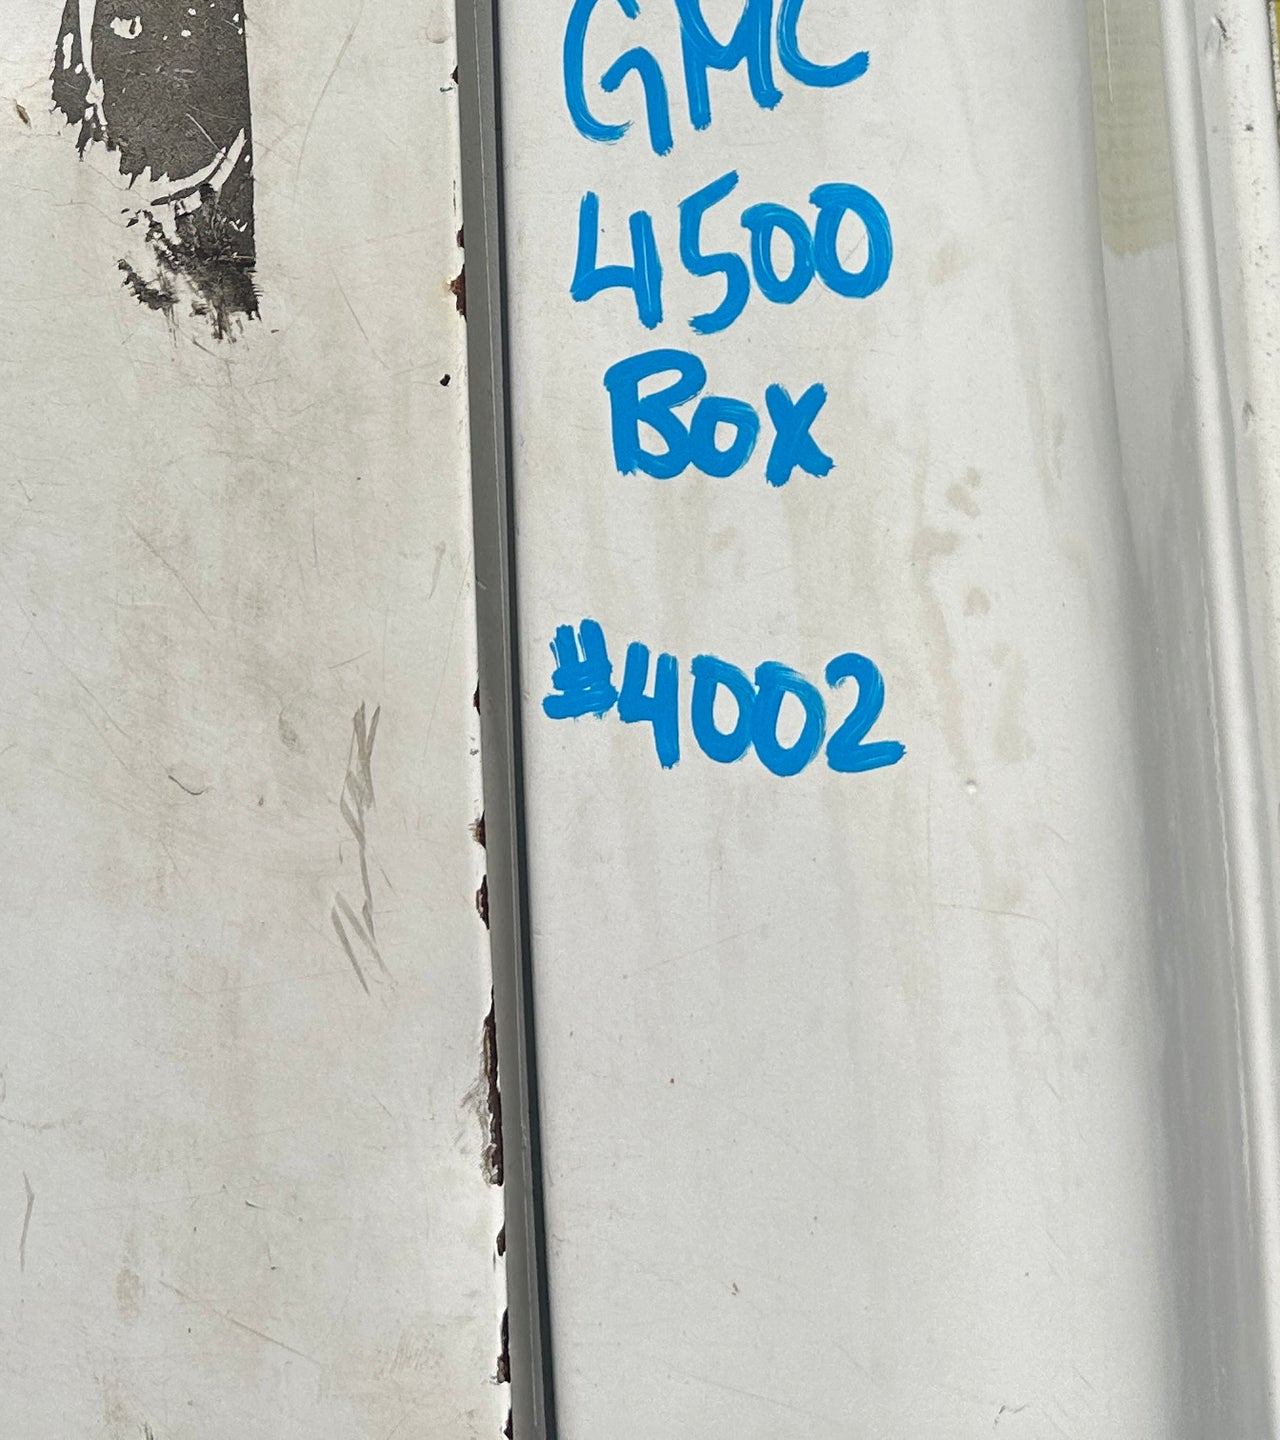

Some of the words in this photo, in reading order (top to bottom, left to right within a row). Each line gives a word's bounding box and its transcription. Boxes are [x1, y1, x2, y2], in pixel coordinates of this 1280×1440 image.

[570, 169, 894, 335] 4500
[604, 348, 837, 488] Box
[542, 618, 907, 778] #4002
